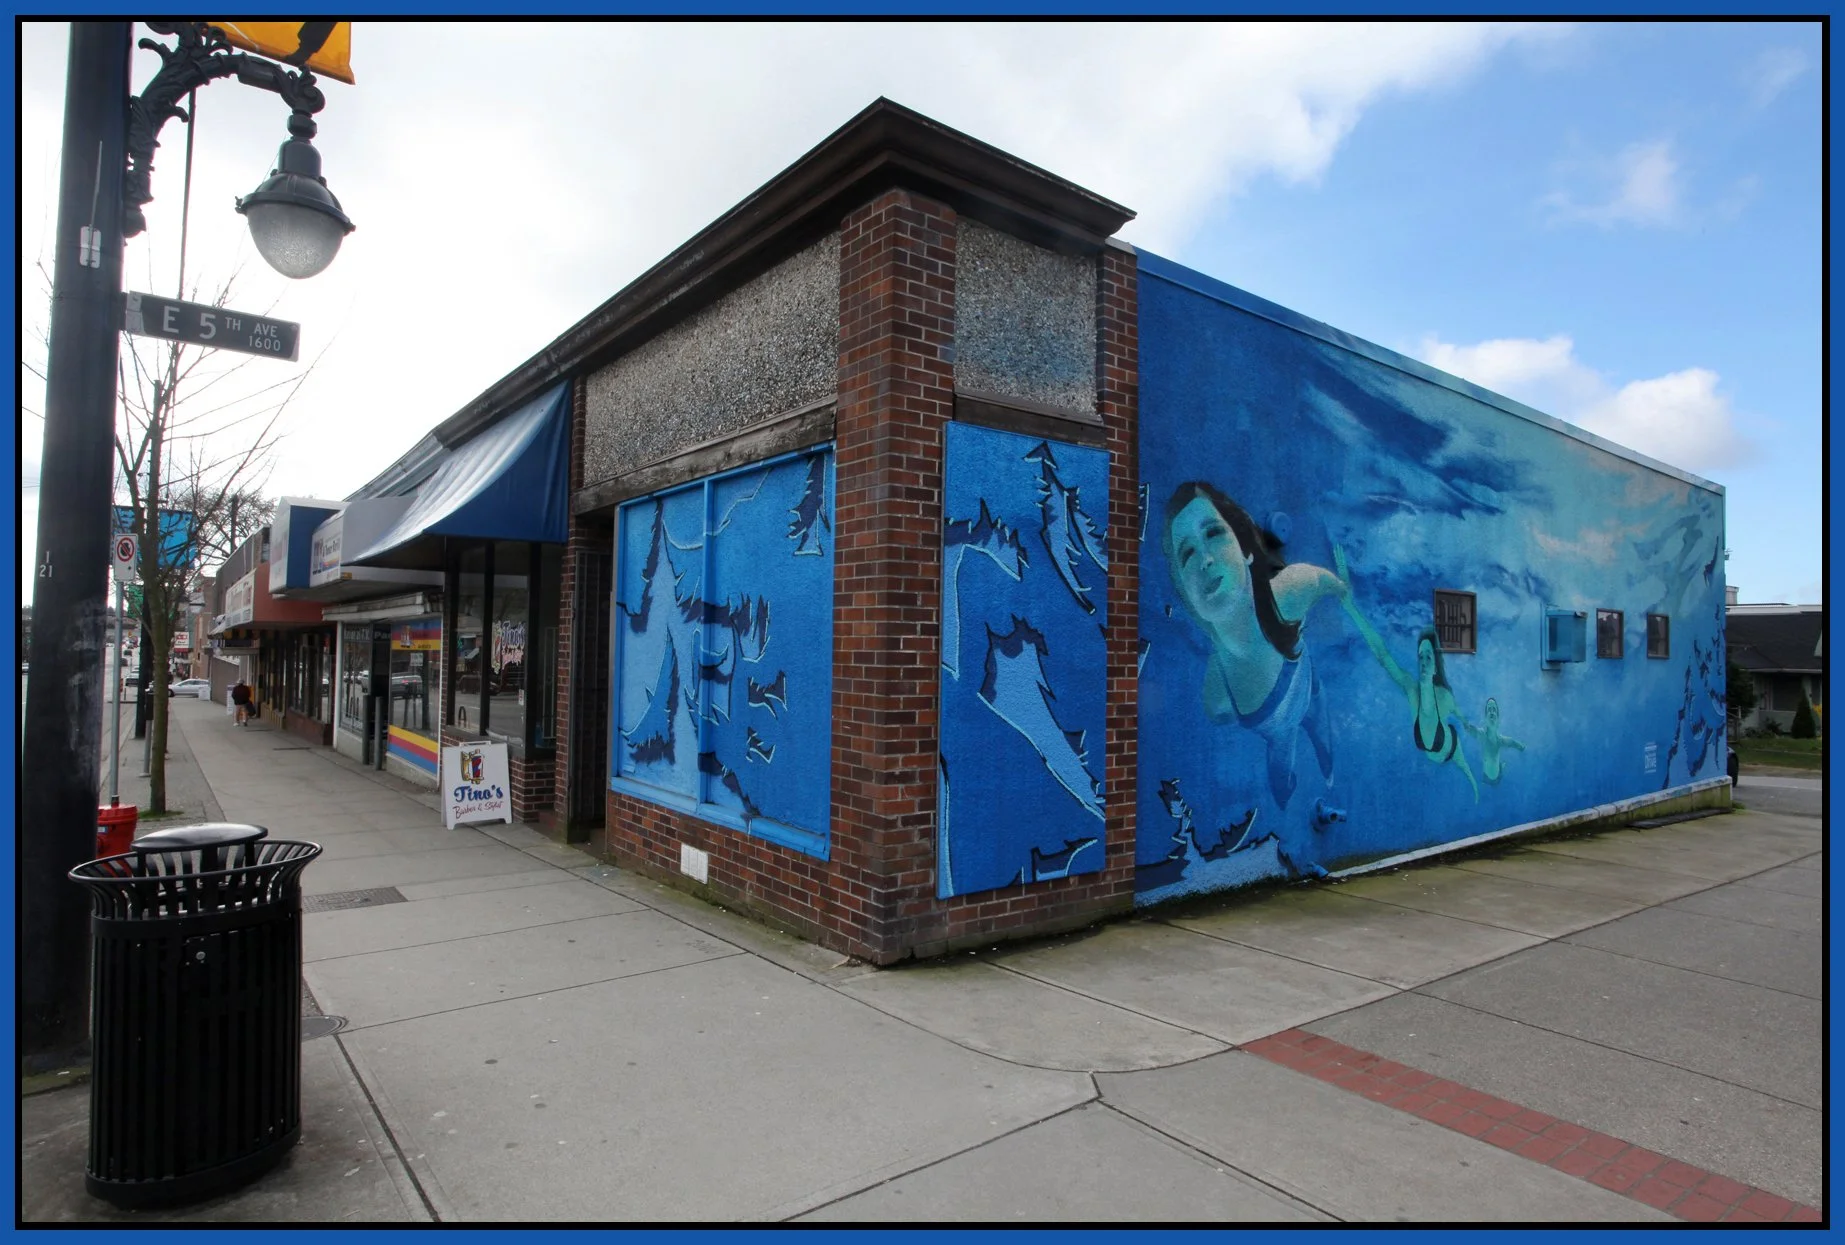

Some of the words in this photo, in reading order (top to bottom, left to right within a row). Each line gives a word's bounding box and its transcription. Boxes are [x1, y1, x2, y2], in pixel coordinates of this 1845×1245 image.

[163, 305, 180, 334] E
[254, 322, 278, 338] AVE
[248, 335, 281, 352] 1600
[39, 564, 53, 578] 21
[453, 784, 504, 803] Tino's
